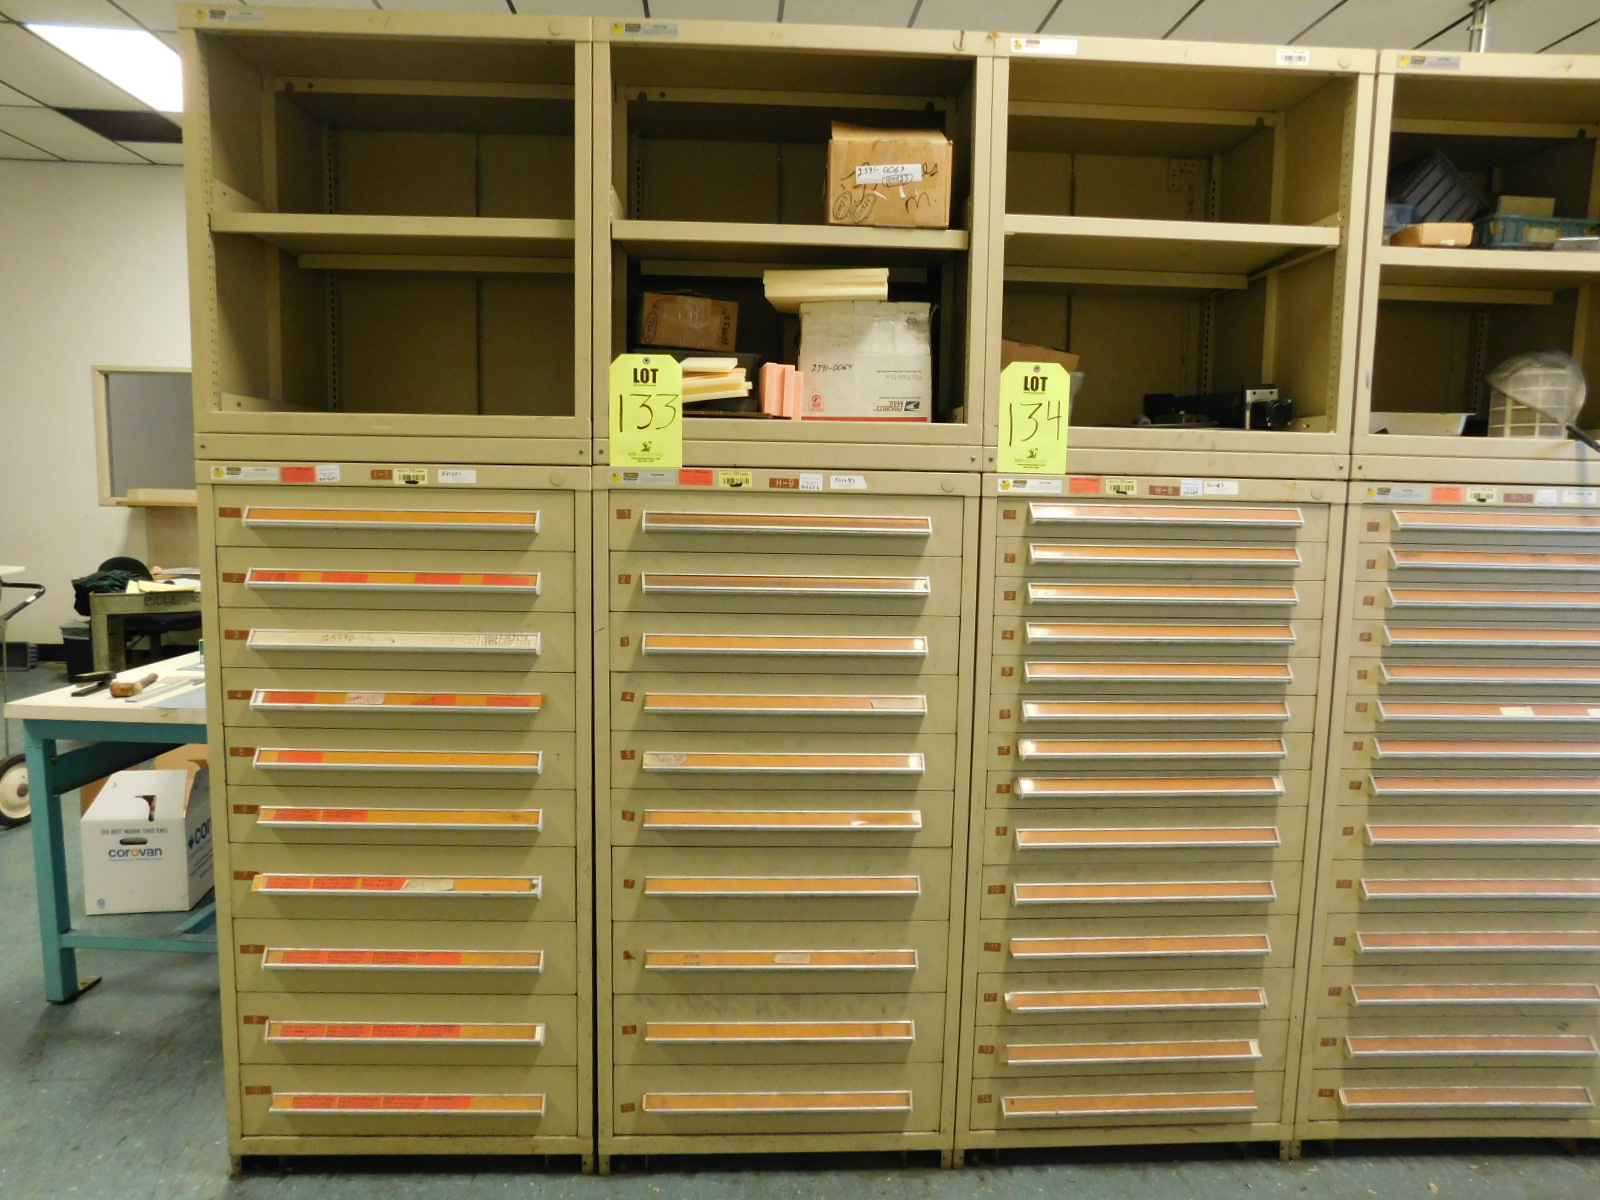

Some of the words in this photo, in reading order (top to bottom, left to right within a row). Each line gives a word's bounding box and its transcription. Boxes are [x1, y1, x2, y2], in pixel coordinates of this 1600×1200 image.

[633, 368, 659, 384] LOT
[1023, 376, 1049, 392] LOT
[619, 393, 680, 433] 133
[1008, 400, 1062, 447] 134
[775, 480, 795, 488] H-9
